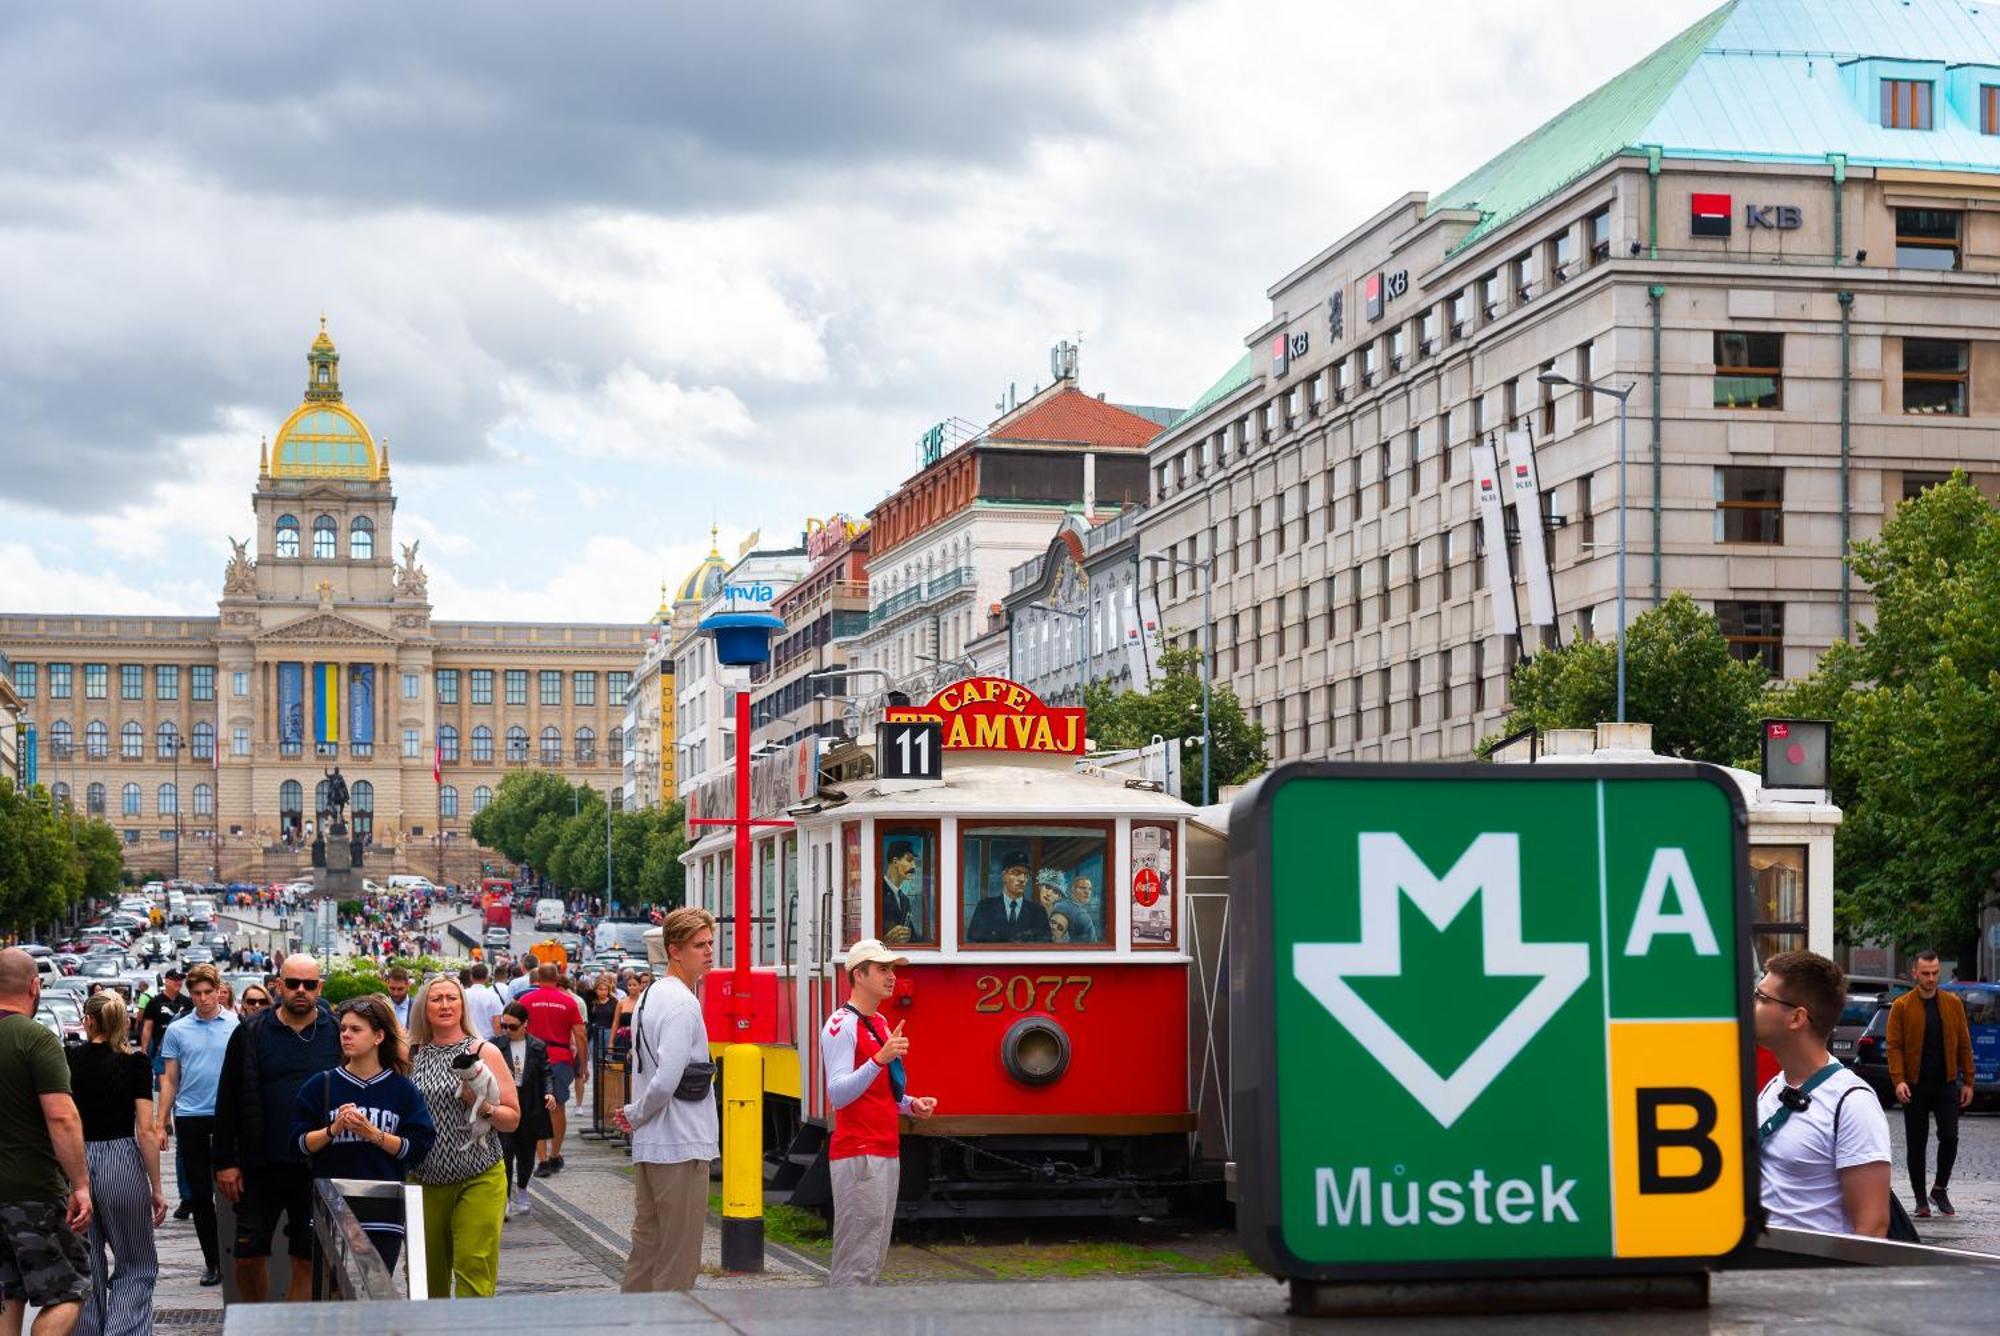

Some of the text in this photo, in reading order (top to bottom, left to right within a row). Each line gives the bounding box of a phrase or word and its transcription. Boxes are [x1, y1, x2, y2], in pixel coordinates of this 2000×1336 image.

[1746, 204, 1802, 230] KB
[1385, 269, 1408, 303] KB
[1289, 331, 1309, 361] KB
[1515, 481, 1532, 489] KB
[724, 581, 773, 601] invia
[939, 681, 1032, 712] CAFE
[890, 713, 1080, 752] AMVAJ
[896, 727, 929, 775] 11
[1624, 847, 1721, 956] A
[976, 975, 1092, 1012] 2077
[1635, 1087, 1723, 1195] B
[1315, 1164, 1580, 1227] Můstek
